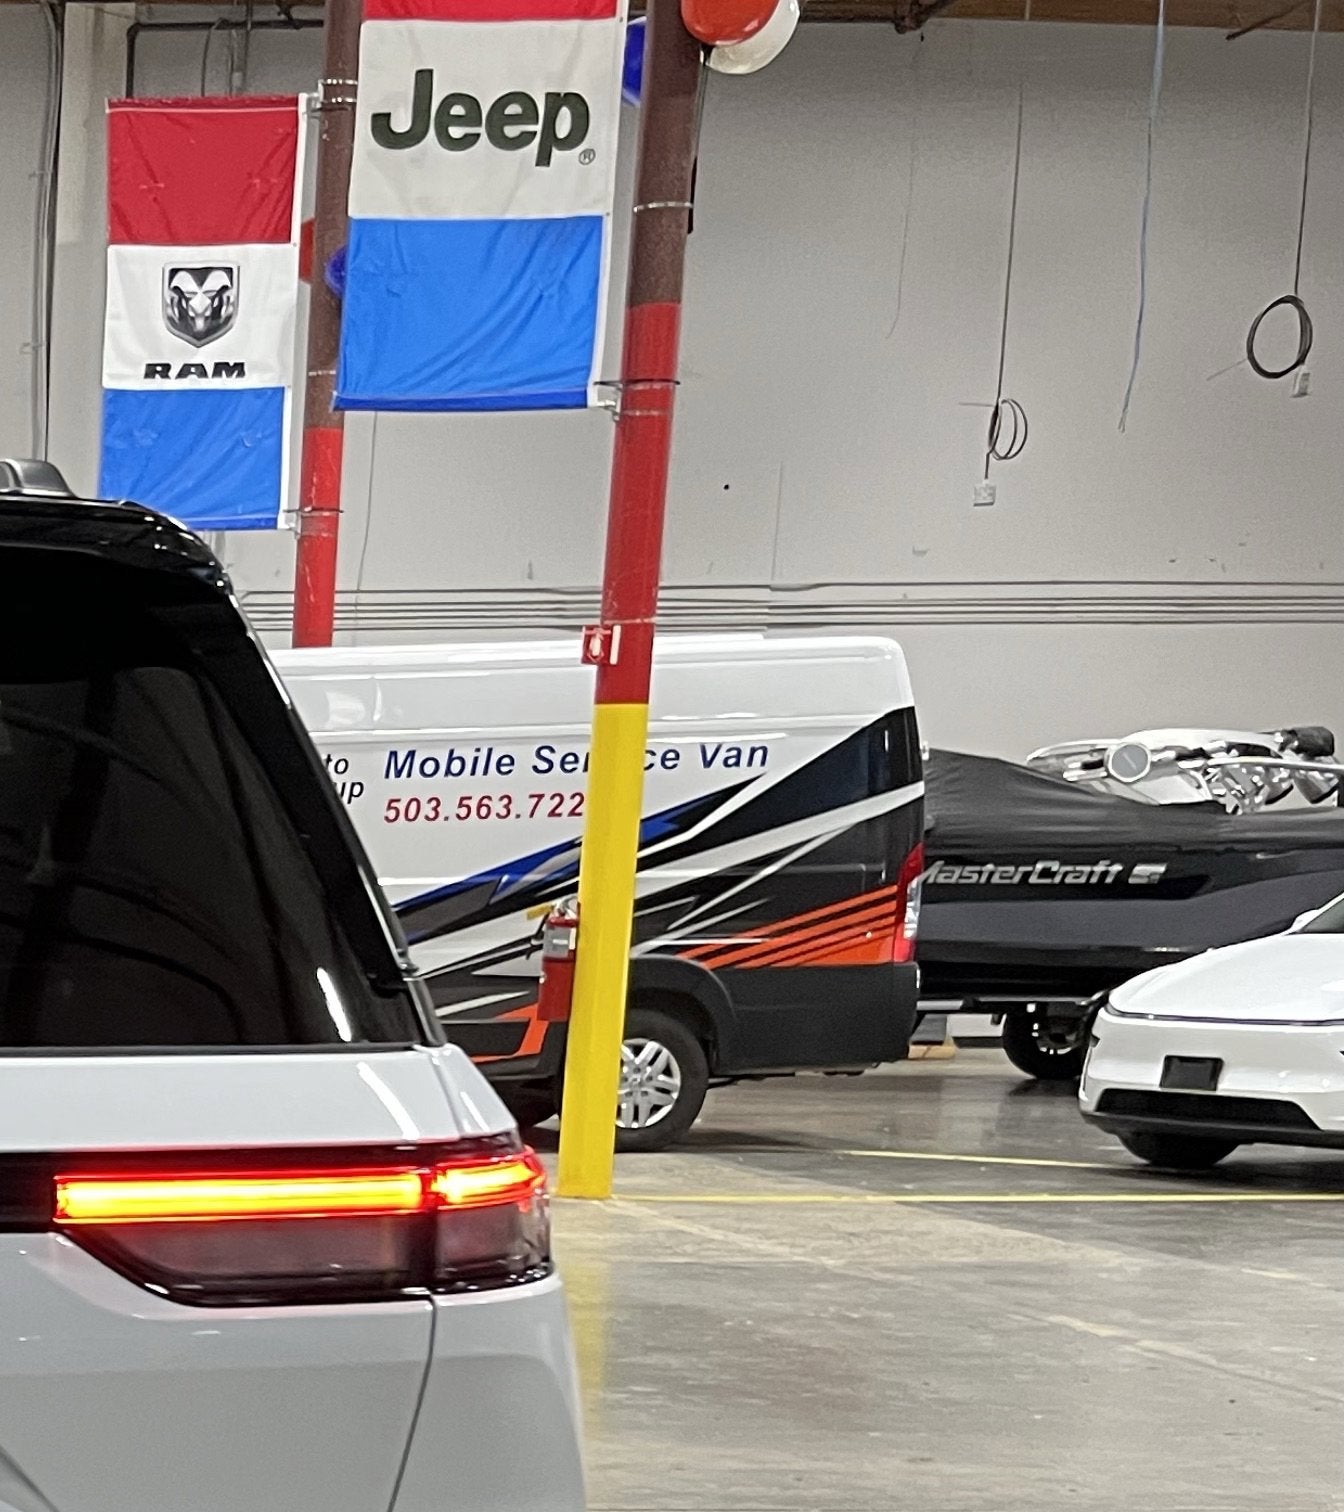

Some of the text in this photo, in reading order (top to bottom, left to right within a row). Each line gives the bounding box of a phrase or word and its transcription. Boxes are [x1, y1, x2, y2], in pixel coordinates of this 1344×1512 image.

[371, 69, 590, 167] Jeep
[143, 361, 246, 380] RAM
[384, 748, 516, 780] Mobile
[700, 742, 770, 770] Van
[384, 791, 586, 824] 503.563.722
